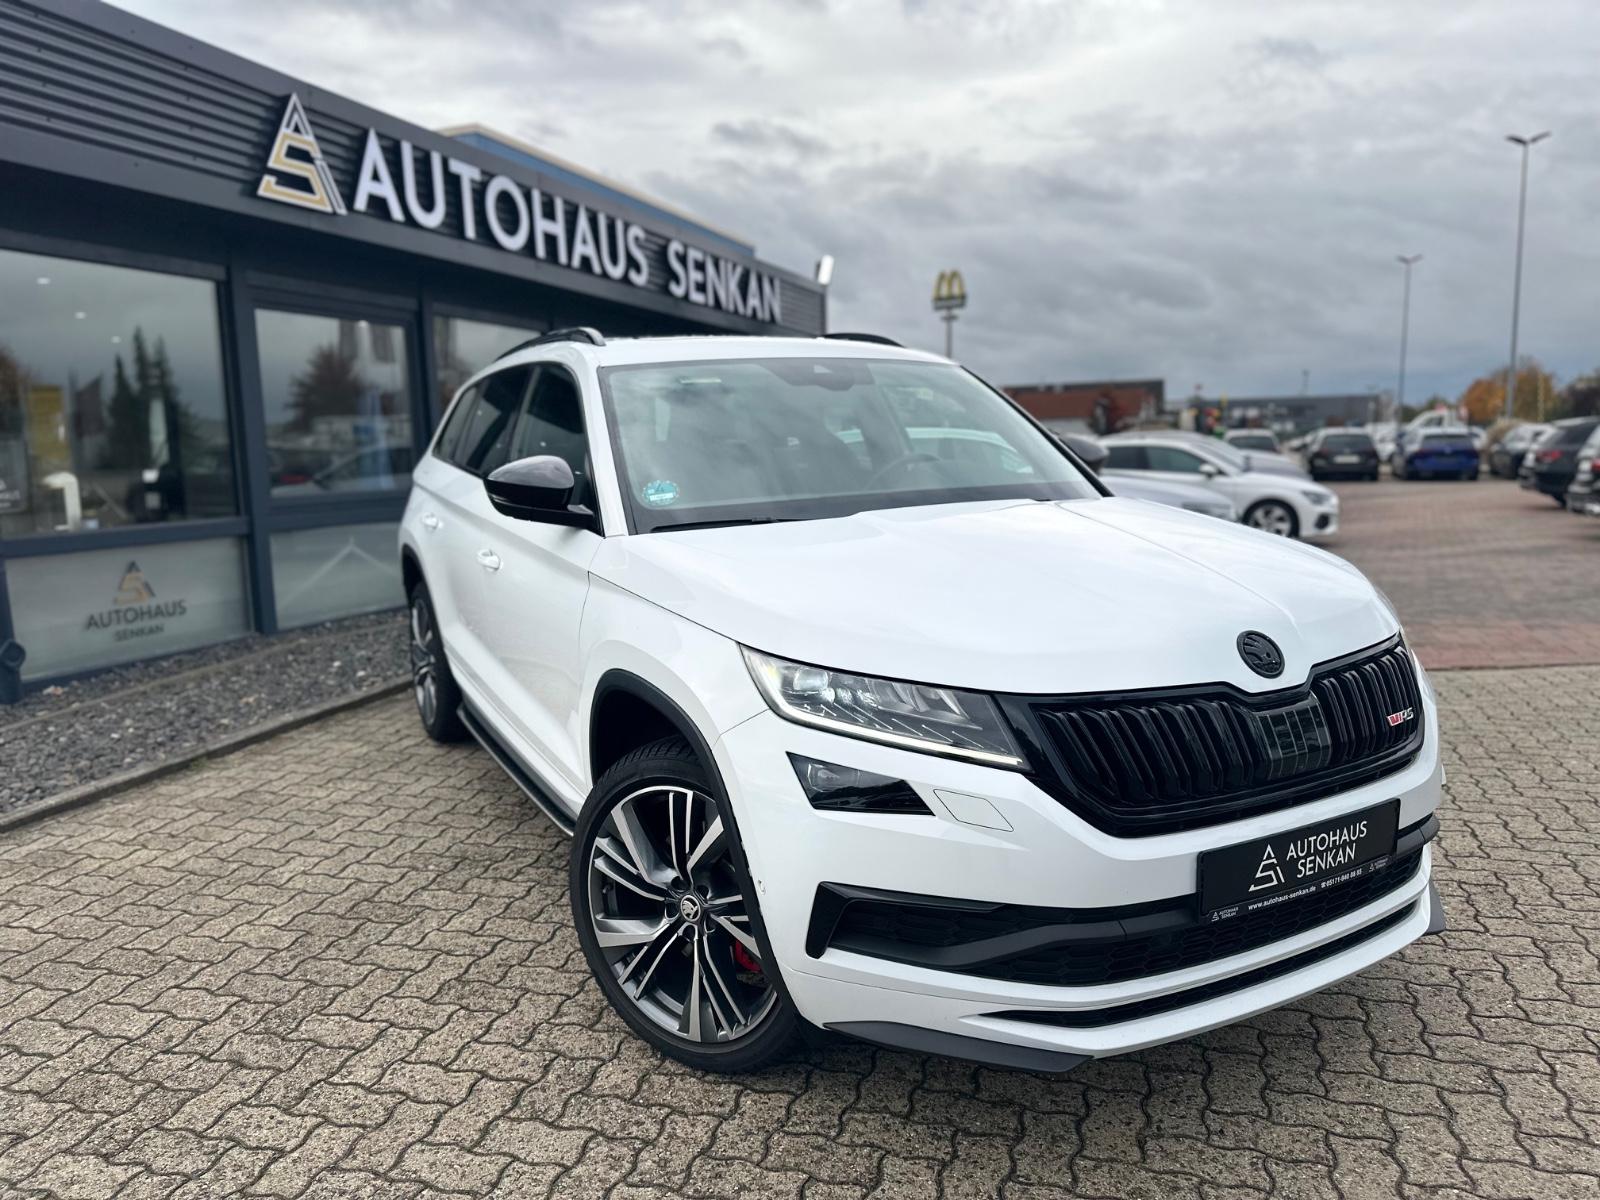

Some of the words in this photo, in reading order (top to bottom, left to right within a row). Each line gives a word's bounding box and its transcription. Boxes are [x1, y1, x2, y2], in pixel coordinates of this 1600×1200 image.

[353, 127, 649, 287] AUTOHAUS
[667, 239, 781, 323] SENKAN
[84, 599, 187, 631] AUTOHAUS
[114, 624, 165, 641] SENKAN
[1286, 821, 1367, 861] AUTOHAUS
[1297, 843, 1356, 878] SENKAN
[1248, 886, 1316, 910] www.autohaus-senkan.de
